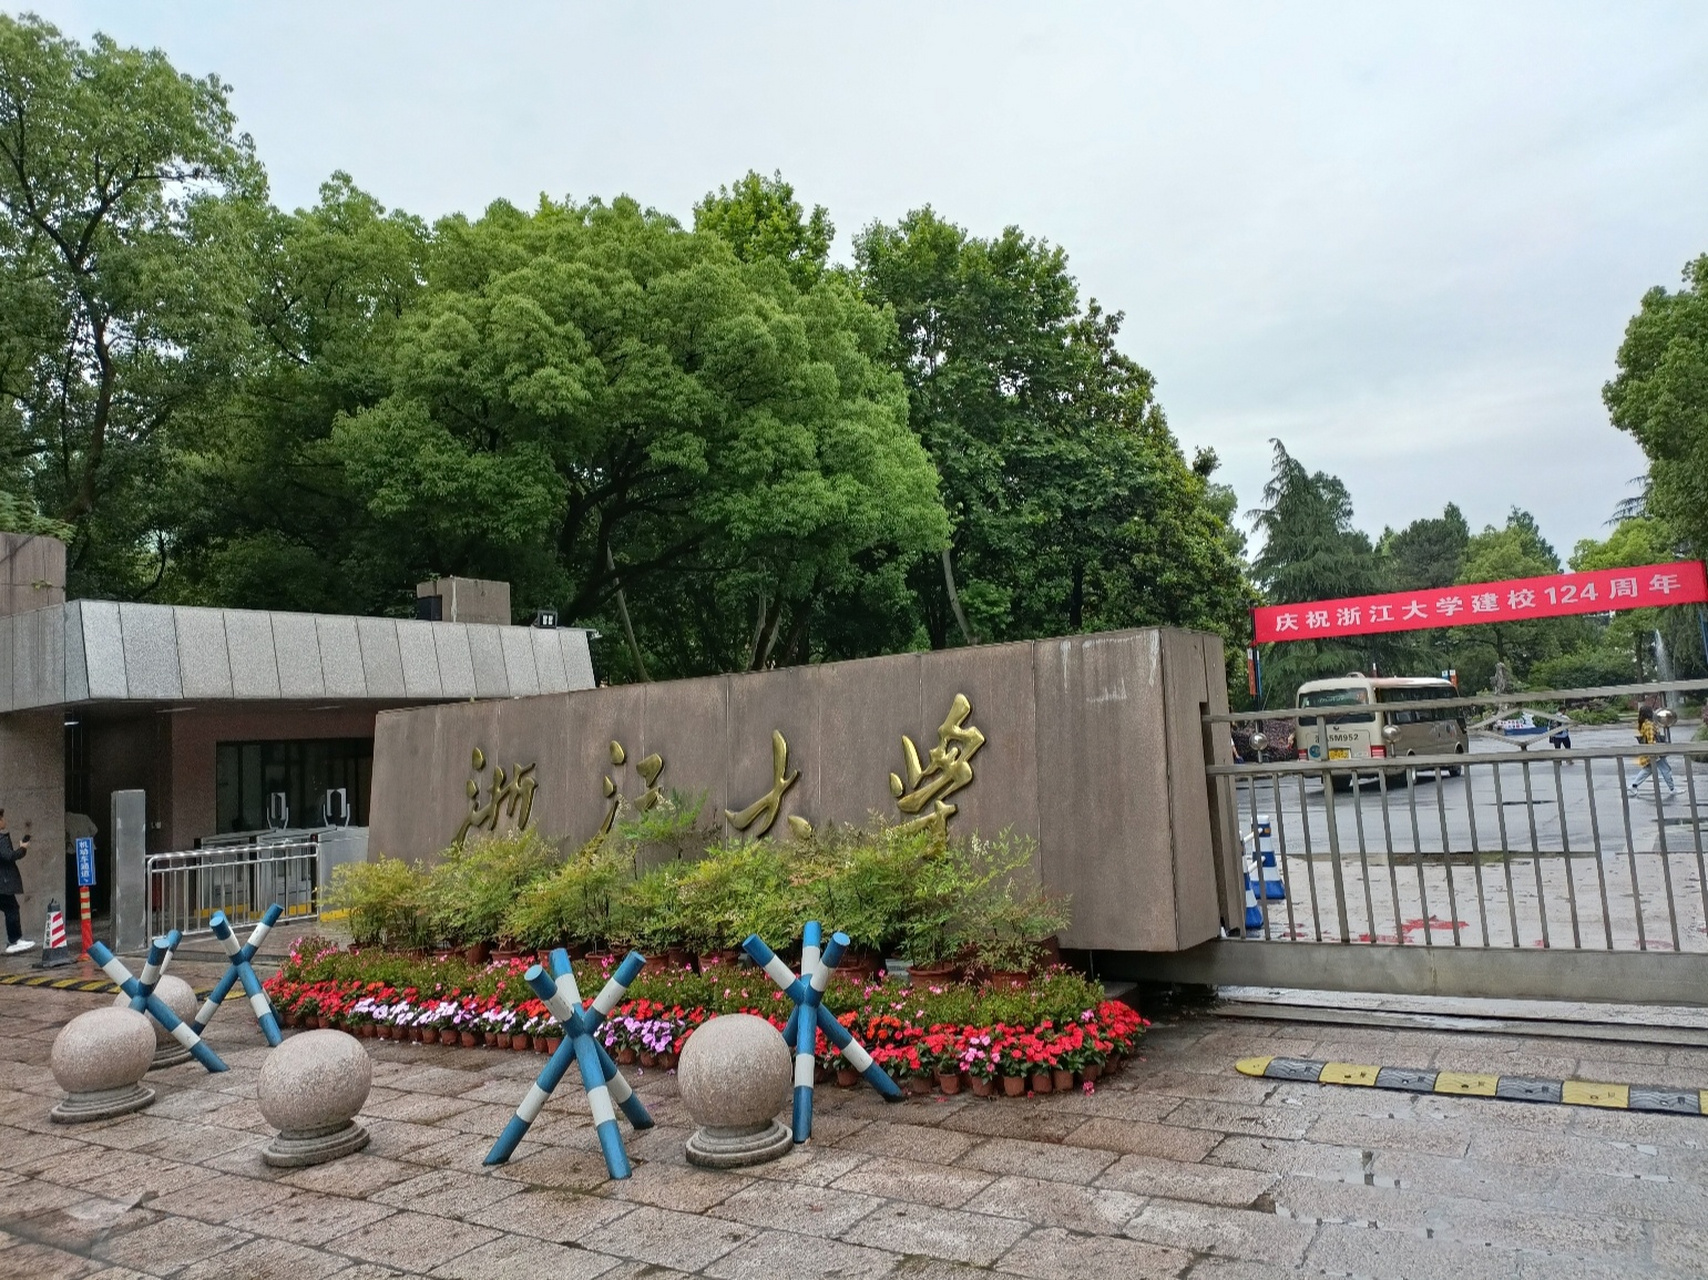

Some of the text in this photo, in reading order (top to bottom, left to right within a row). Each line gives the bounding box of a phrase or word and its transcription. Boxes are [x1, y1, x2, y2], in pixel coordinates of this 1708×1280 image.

[1275, 573, 1681, 632] 庆祝浙江大学建校124周年
